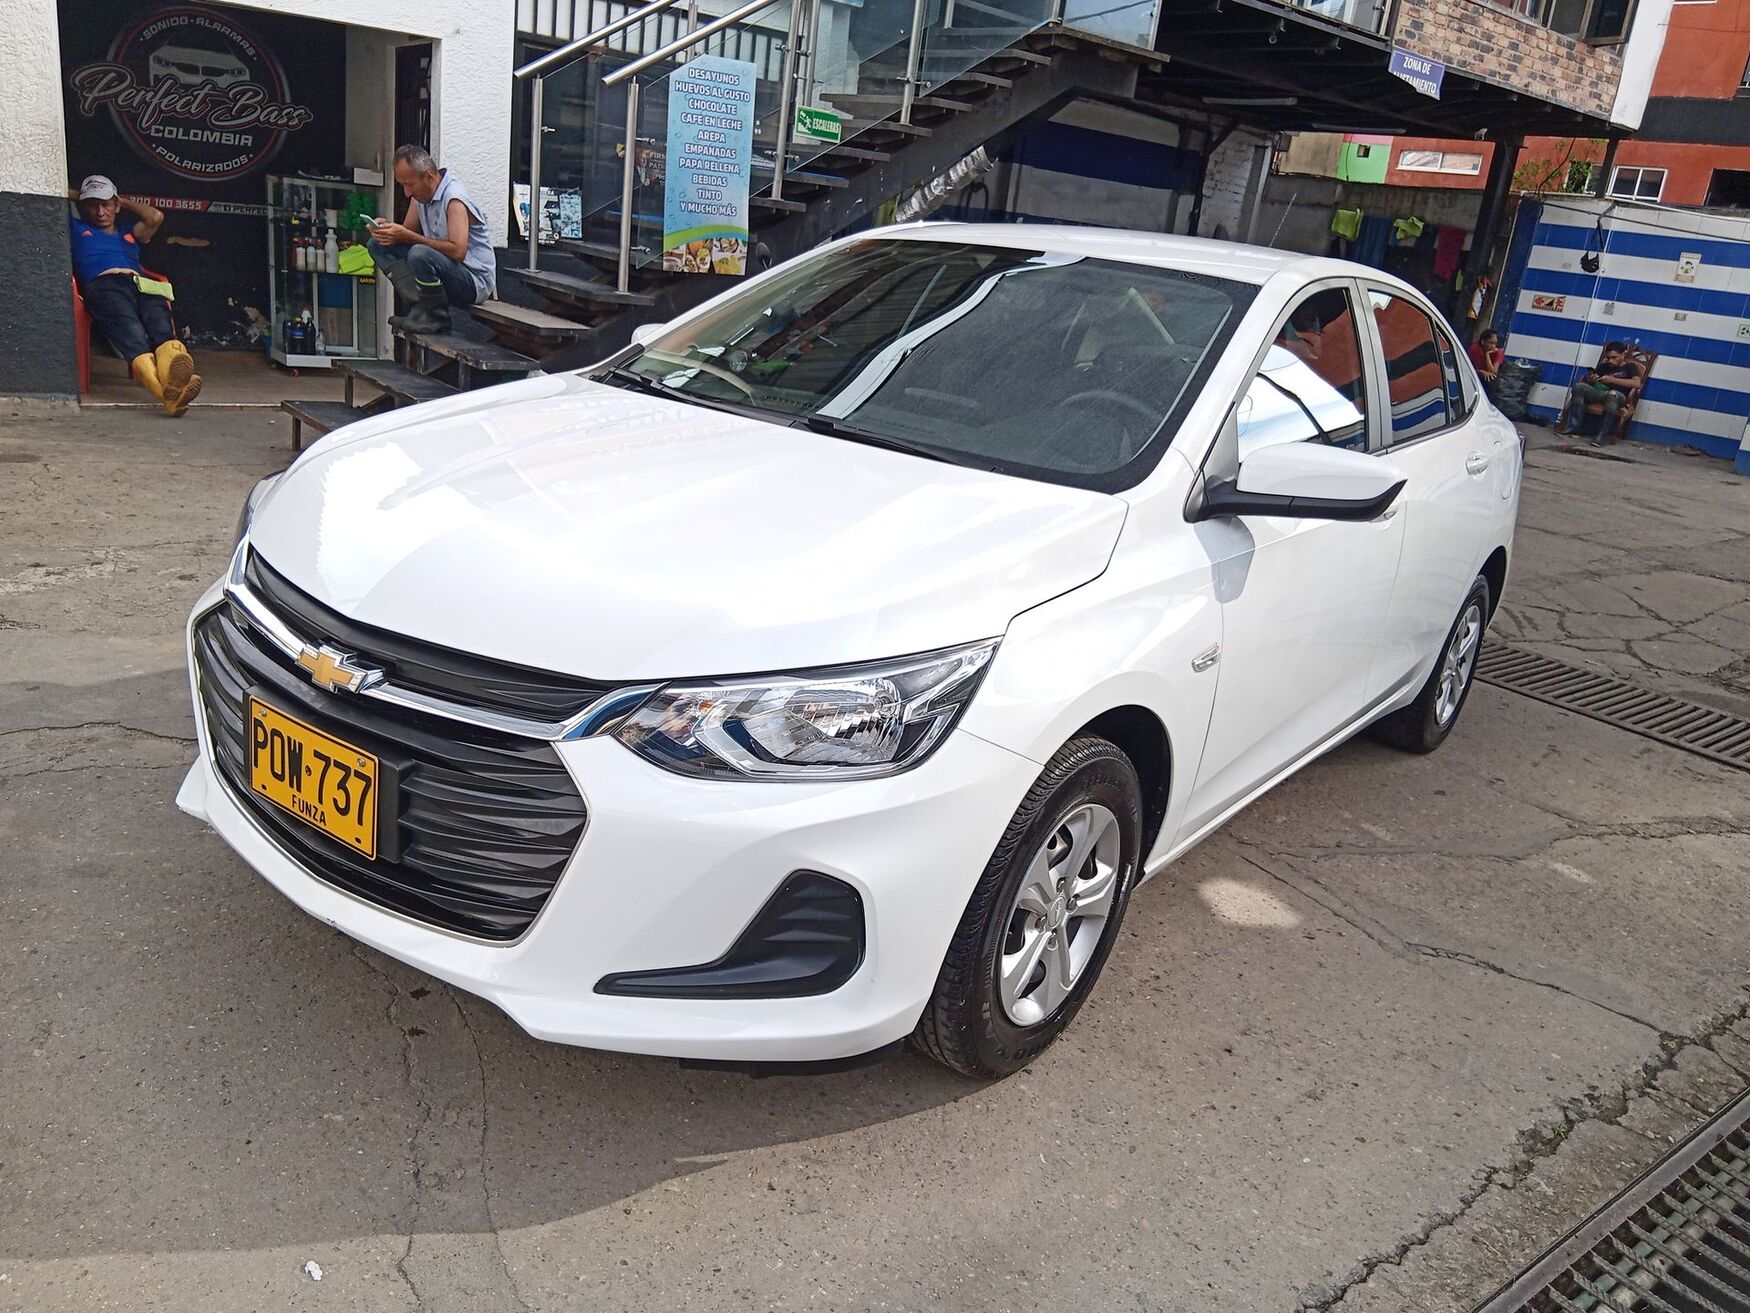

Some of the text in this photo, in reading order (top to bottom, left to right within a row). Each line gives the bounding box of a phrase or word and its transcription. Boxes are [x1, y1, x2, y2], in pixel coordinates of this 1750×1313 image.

[143, 16, 254, 57] SONIDO ALARMAS
[1403, 56, 1432, 75] ZONA DE
[689, 68, 739, 85] DESAYUNOS
[71, 65, 311, 132] Perfect Bass
[675, 82, 750, 102] HUEVOS AL GUSTO
[688, 98, 737, 115] CHOCOLATE
[681, 113, 742, 130] CAFE EN LECHE
[812, 118, 840, 134] ESCALERAS
[150, 125, 253, 148] COLOMBIA
[697, 130, 726, 143] AREPA
[685, 143, 736, 159] EMPANADAS
[155, 148, 249, 173] POLARIZADOS
[679, 158, 703, 169] PAPA
[704, 161, 740, 174] RELLENA
[692, 174, 727, 187] BEBIDAS
[697, 189, 722, 200] TINTO
[155, 198, 173, 208] 100
[175, 199, 203, 210] 3655
[680, 202, 736, 216] Y MUCHO MÁS
[291, 794, 327, 826] FUNZA
